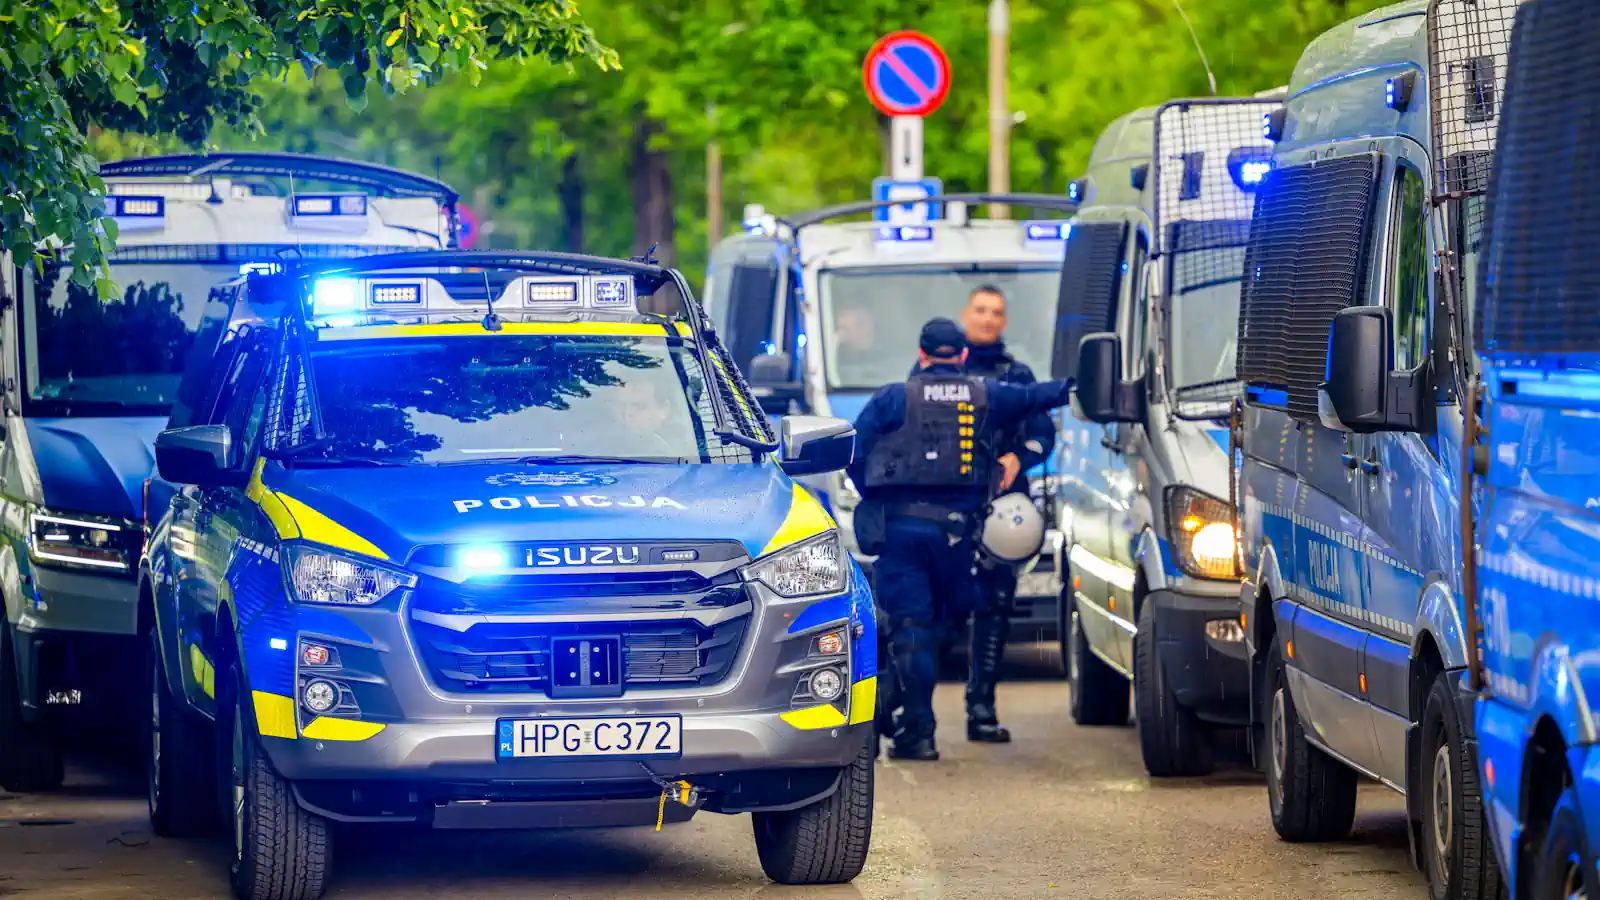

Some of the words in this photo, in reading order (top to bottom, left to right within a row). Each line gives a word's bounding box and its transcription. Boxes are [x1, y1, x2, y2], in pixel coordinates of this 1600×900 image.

[924, 384, 971, 402] POLICJA
[452, 495, 689, 514] POLICJA
[526, 547, 639, 566] ISUZU
[1308, 539, 1340, 594] POLICJA
[521, 723, 581, 753] HPG
[594, 721, 671, 751] C372
[501, 743, 512, 752] PL
